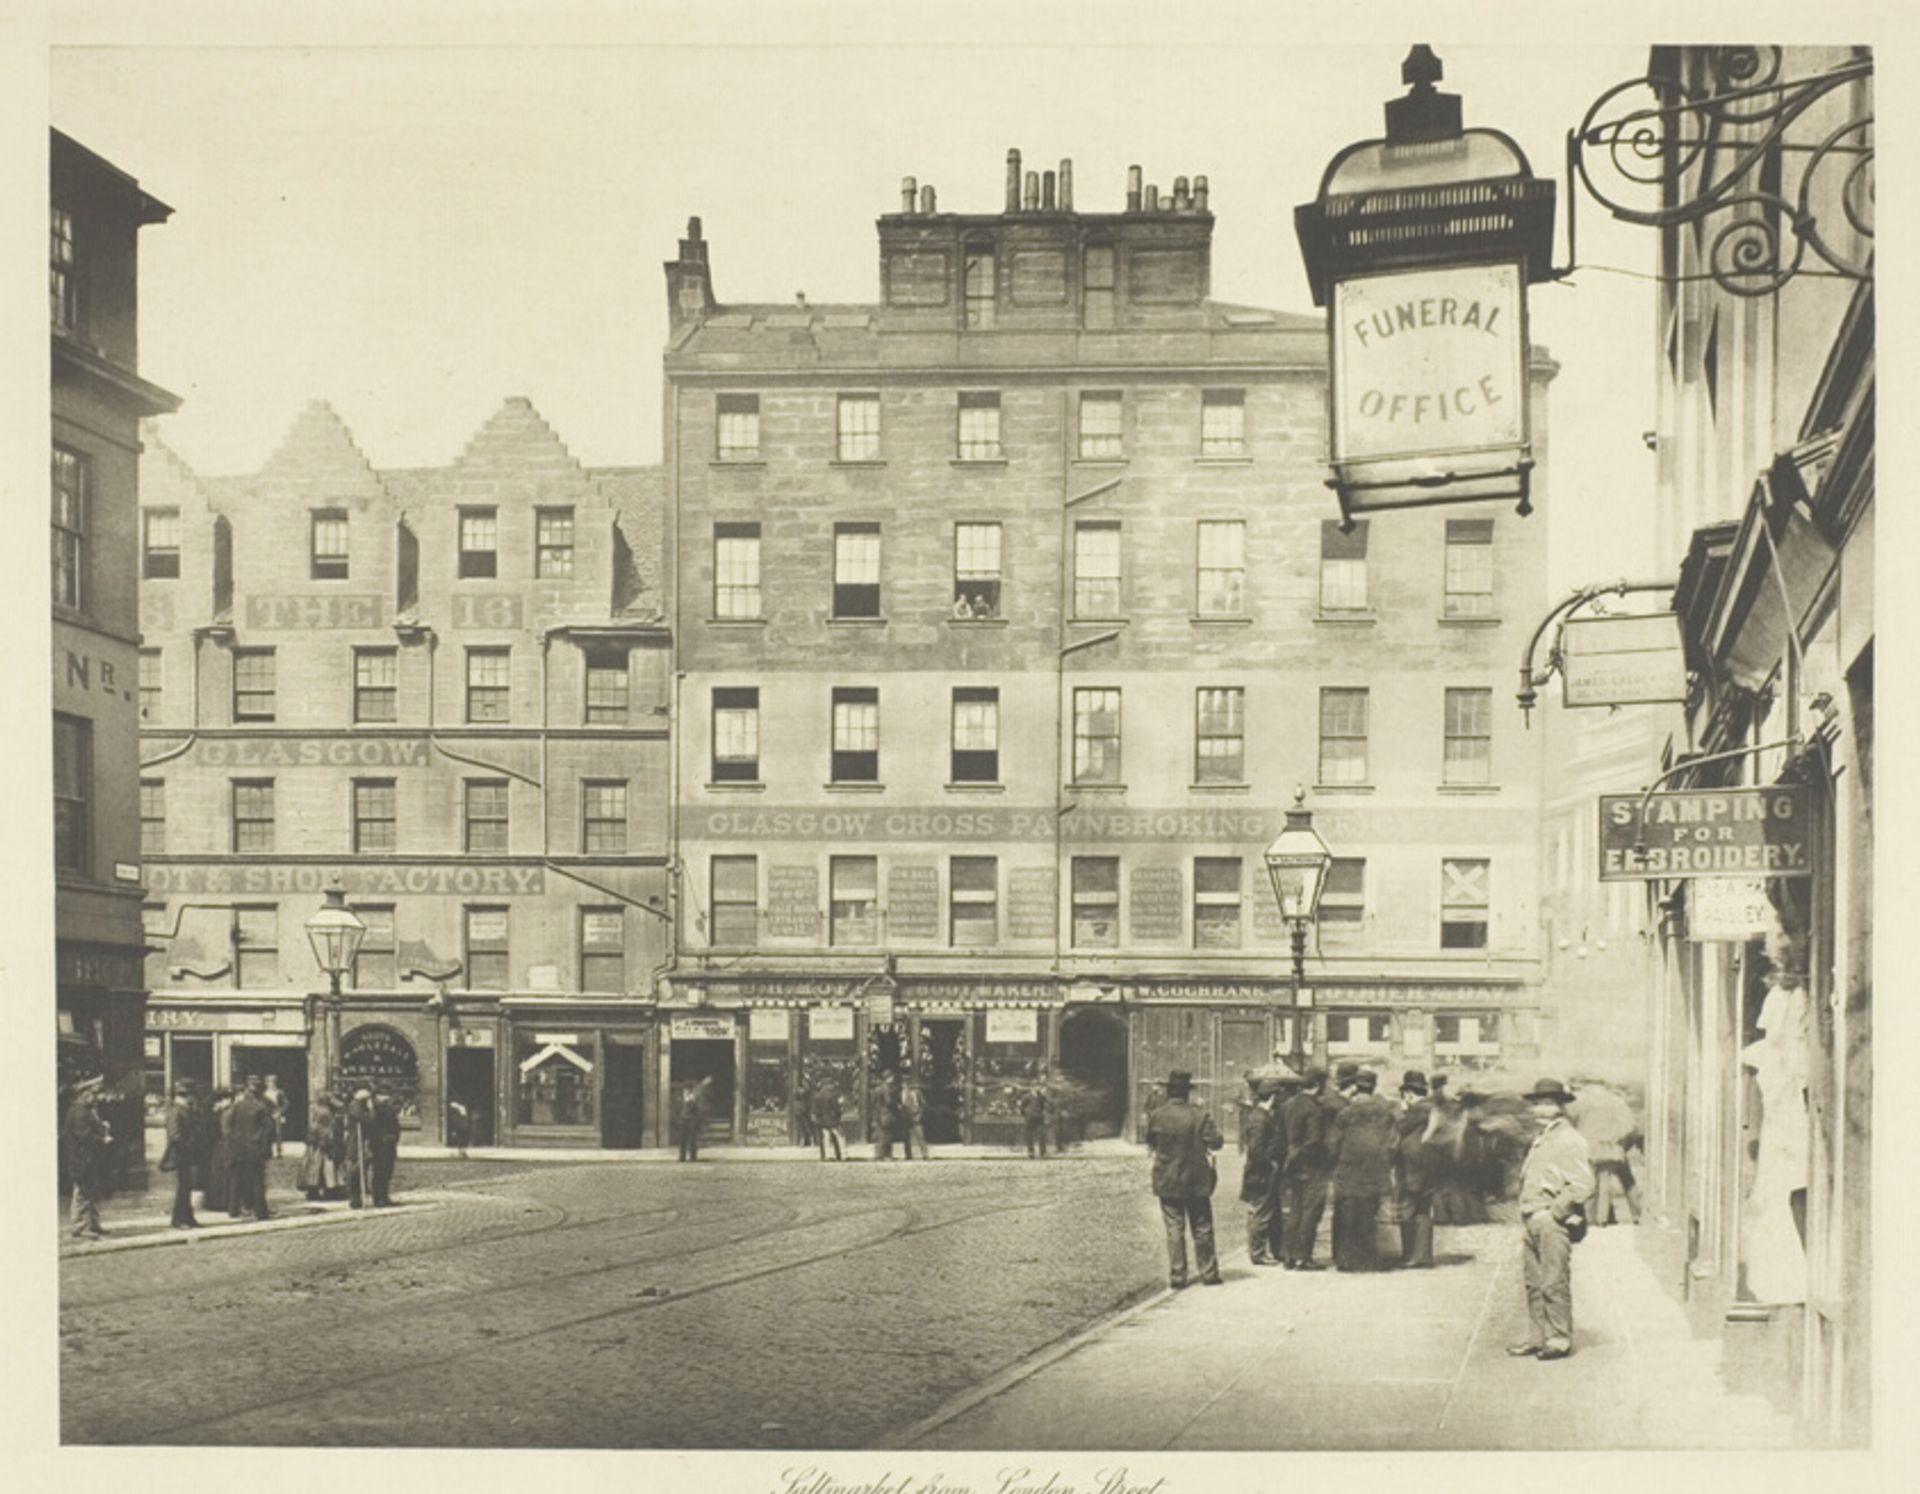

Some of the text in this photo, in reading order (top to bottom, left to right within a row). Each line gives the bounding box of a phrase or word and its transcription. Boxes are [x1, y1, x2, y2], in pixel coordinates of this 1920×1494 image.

[1352, 297, 1502, 349] FUNERAL
[1358, 373, 1503, 424] OFFICE
[256, 596, 374, 628] THE
[458, 596, 512, 628] 16
[201, 740, 427, 766] GLASGOW,
[1611, 795, 1794, 825] STAMPING
[707, 813, 1264, 837] GLASGOW CROSS PAWNBROKING
[1673, 826, 1735, 842] FOR
[141, 866, 193, 891] OT
[206, 866, 232, 892] &
[250, 867, 344, 892] SHOE
[359, 867, 541, 894] FACTORY.
